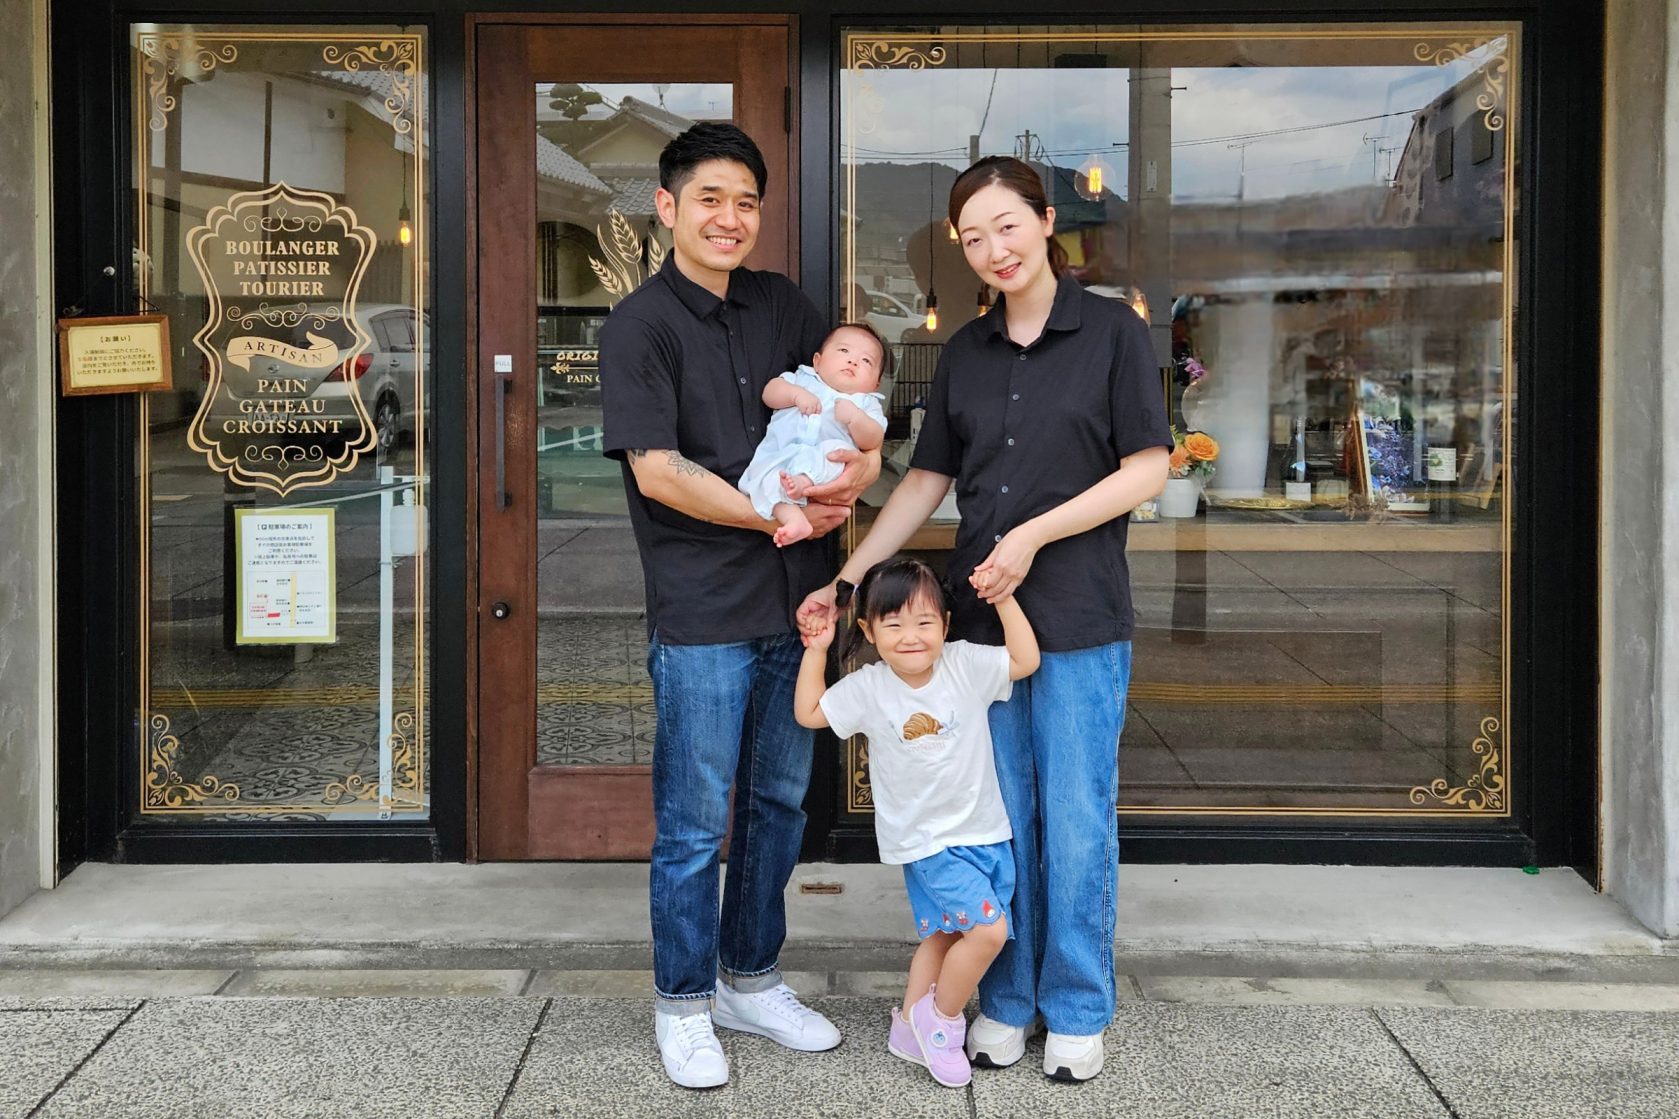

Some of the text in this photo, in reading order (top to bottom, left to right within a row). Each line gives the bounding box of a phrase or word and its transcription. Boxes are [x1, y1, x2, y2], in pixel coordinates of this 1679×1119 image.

[225, 240, 340, 256] BOULANGER
[233, 260, 331, 276] PATISSIER
[239, 281, 325, 296] TOURIER
[243, 340, 323, 364] ARTISAN
[256, 378, 308, 394] PAIN
[566, 374, 593, 383] PAIN
[238, 398, 326, 414] GATEAU
[222, 419, 343, 435] CROISSANT
